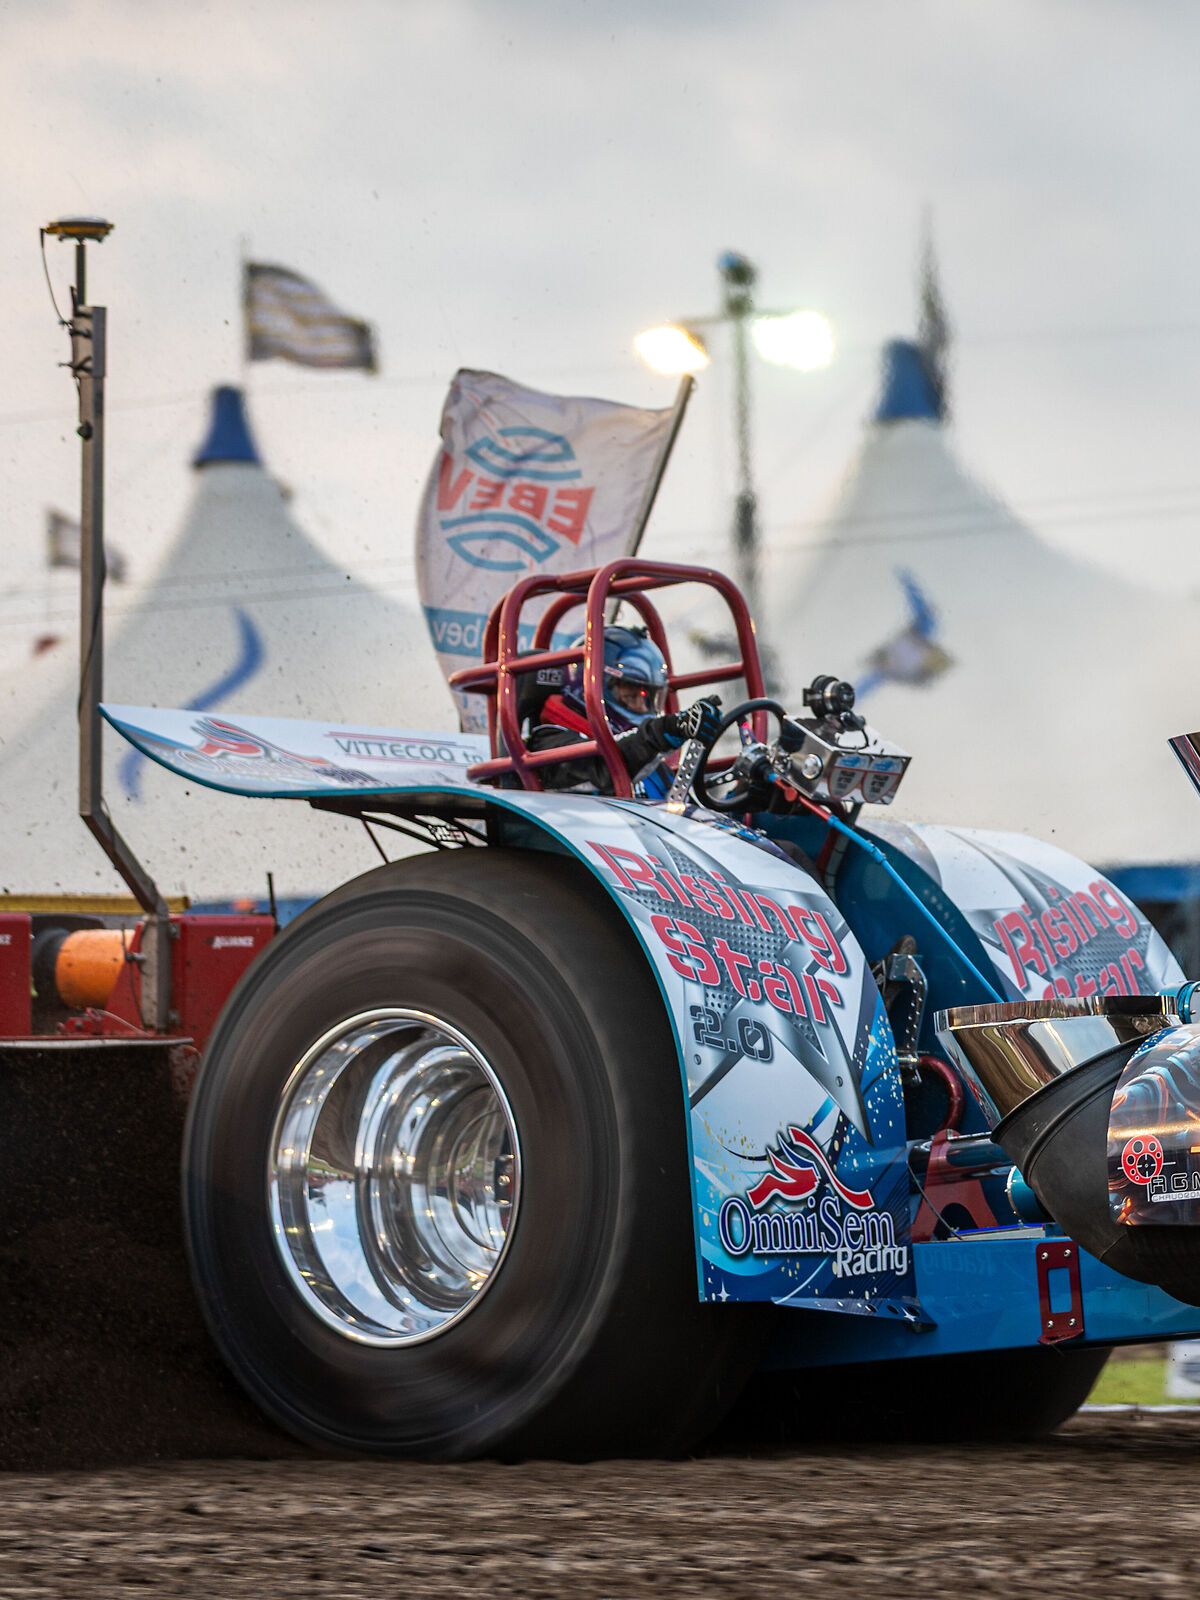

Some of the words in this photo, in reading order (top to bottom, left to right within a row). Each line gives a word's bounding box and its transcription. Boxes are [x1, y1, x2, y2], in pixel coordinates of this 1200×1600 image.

[585, 840, 847, 974] Rising
[993, 879, 1138, 989] Rising
[650, 913, 841, 1024] Star
[689, 1005, 773, 1061] 2.0
[719, 1196, 897, 1255] OmniSem
[837, 1243, 908, 1278] Racing
